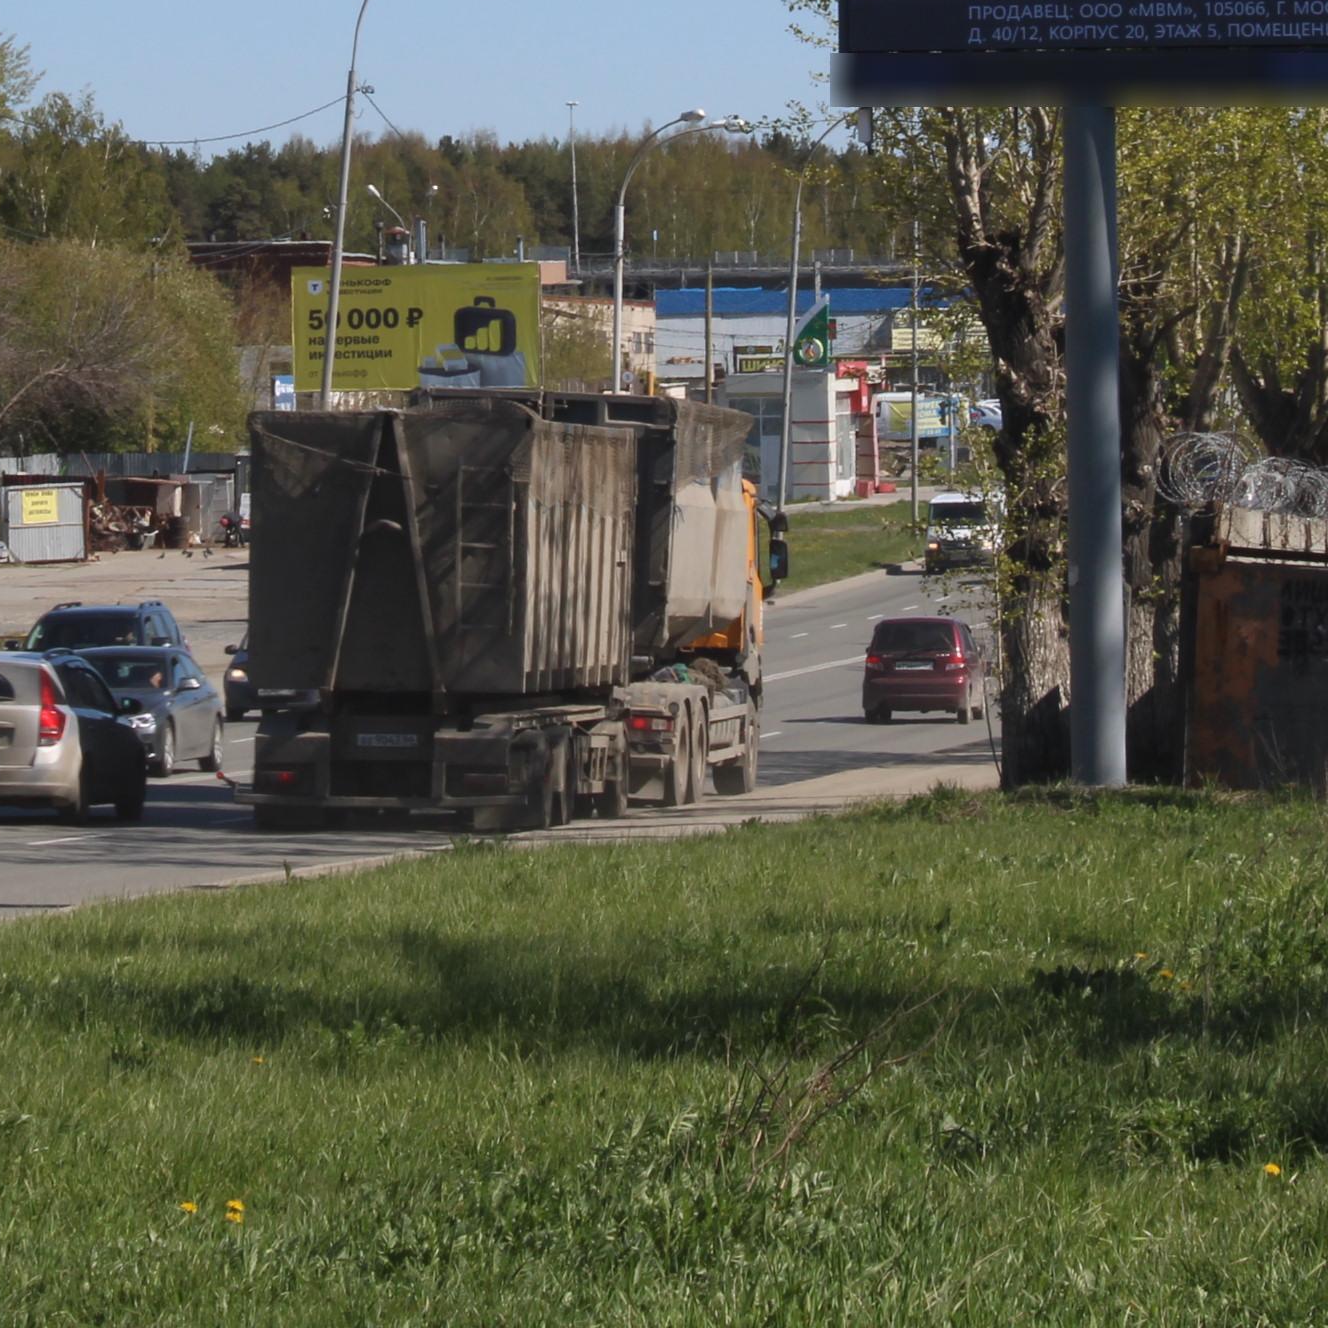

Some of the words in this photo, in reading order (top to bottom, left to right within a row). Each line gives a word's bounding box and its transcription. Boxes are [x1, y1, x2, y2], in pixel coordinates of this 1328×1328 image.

[968, 3, 1073, 22] ПРОДАВЕЦ:
[1079, 2, 1123, 19] ООО
[1128, 1, 1198, 19] «МВМ»,
[1204, 0, 1271, 18] 105066,
[1277, 0, 1291, 16] Г.
[967, 27, 987, 45] Д.
[991, 26, 1043, 43] 40/12,
[1049, 24, 1120, 41] КОРПУС
[1125, 24, 1150, 42] 20,
[1154, 23, 1202, 39] ЭТАЖ
[1207, 23, 1222, 40] 5,
[347, 307, 399, 330] 000
[308, 336, 325, 347] на
[329, 335, 380, 348] ервые
